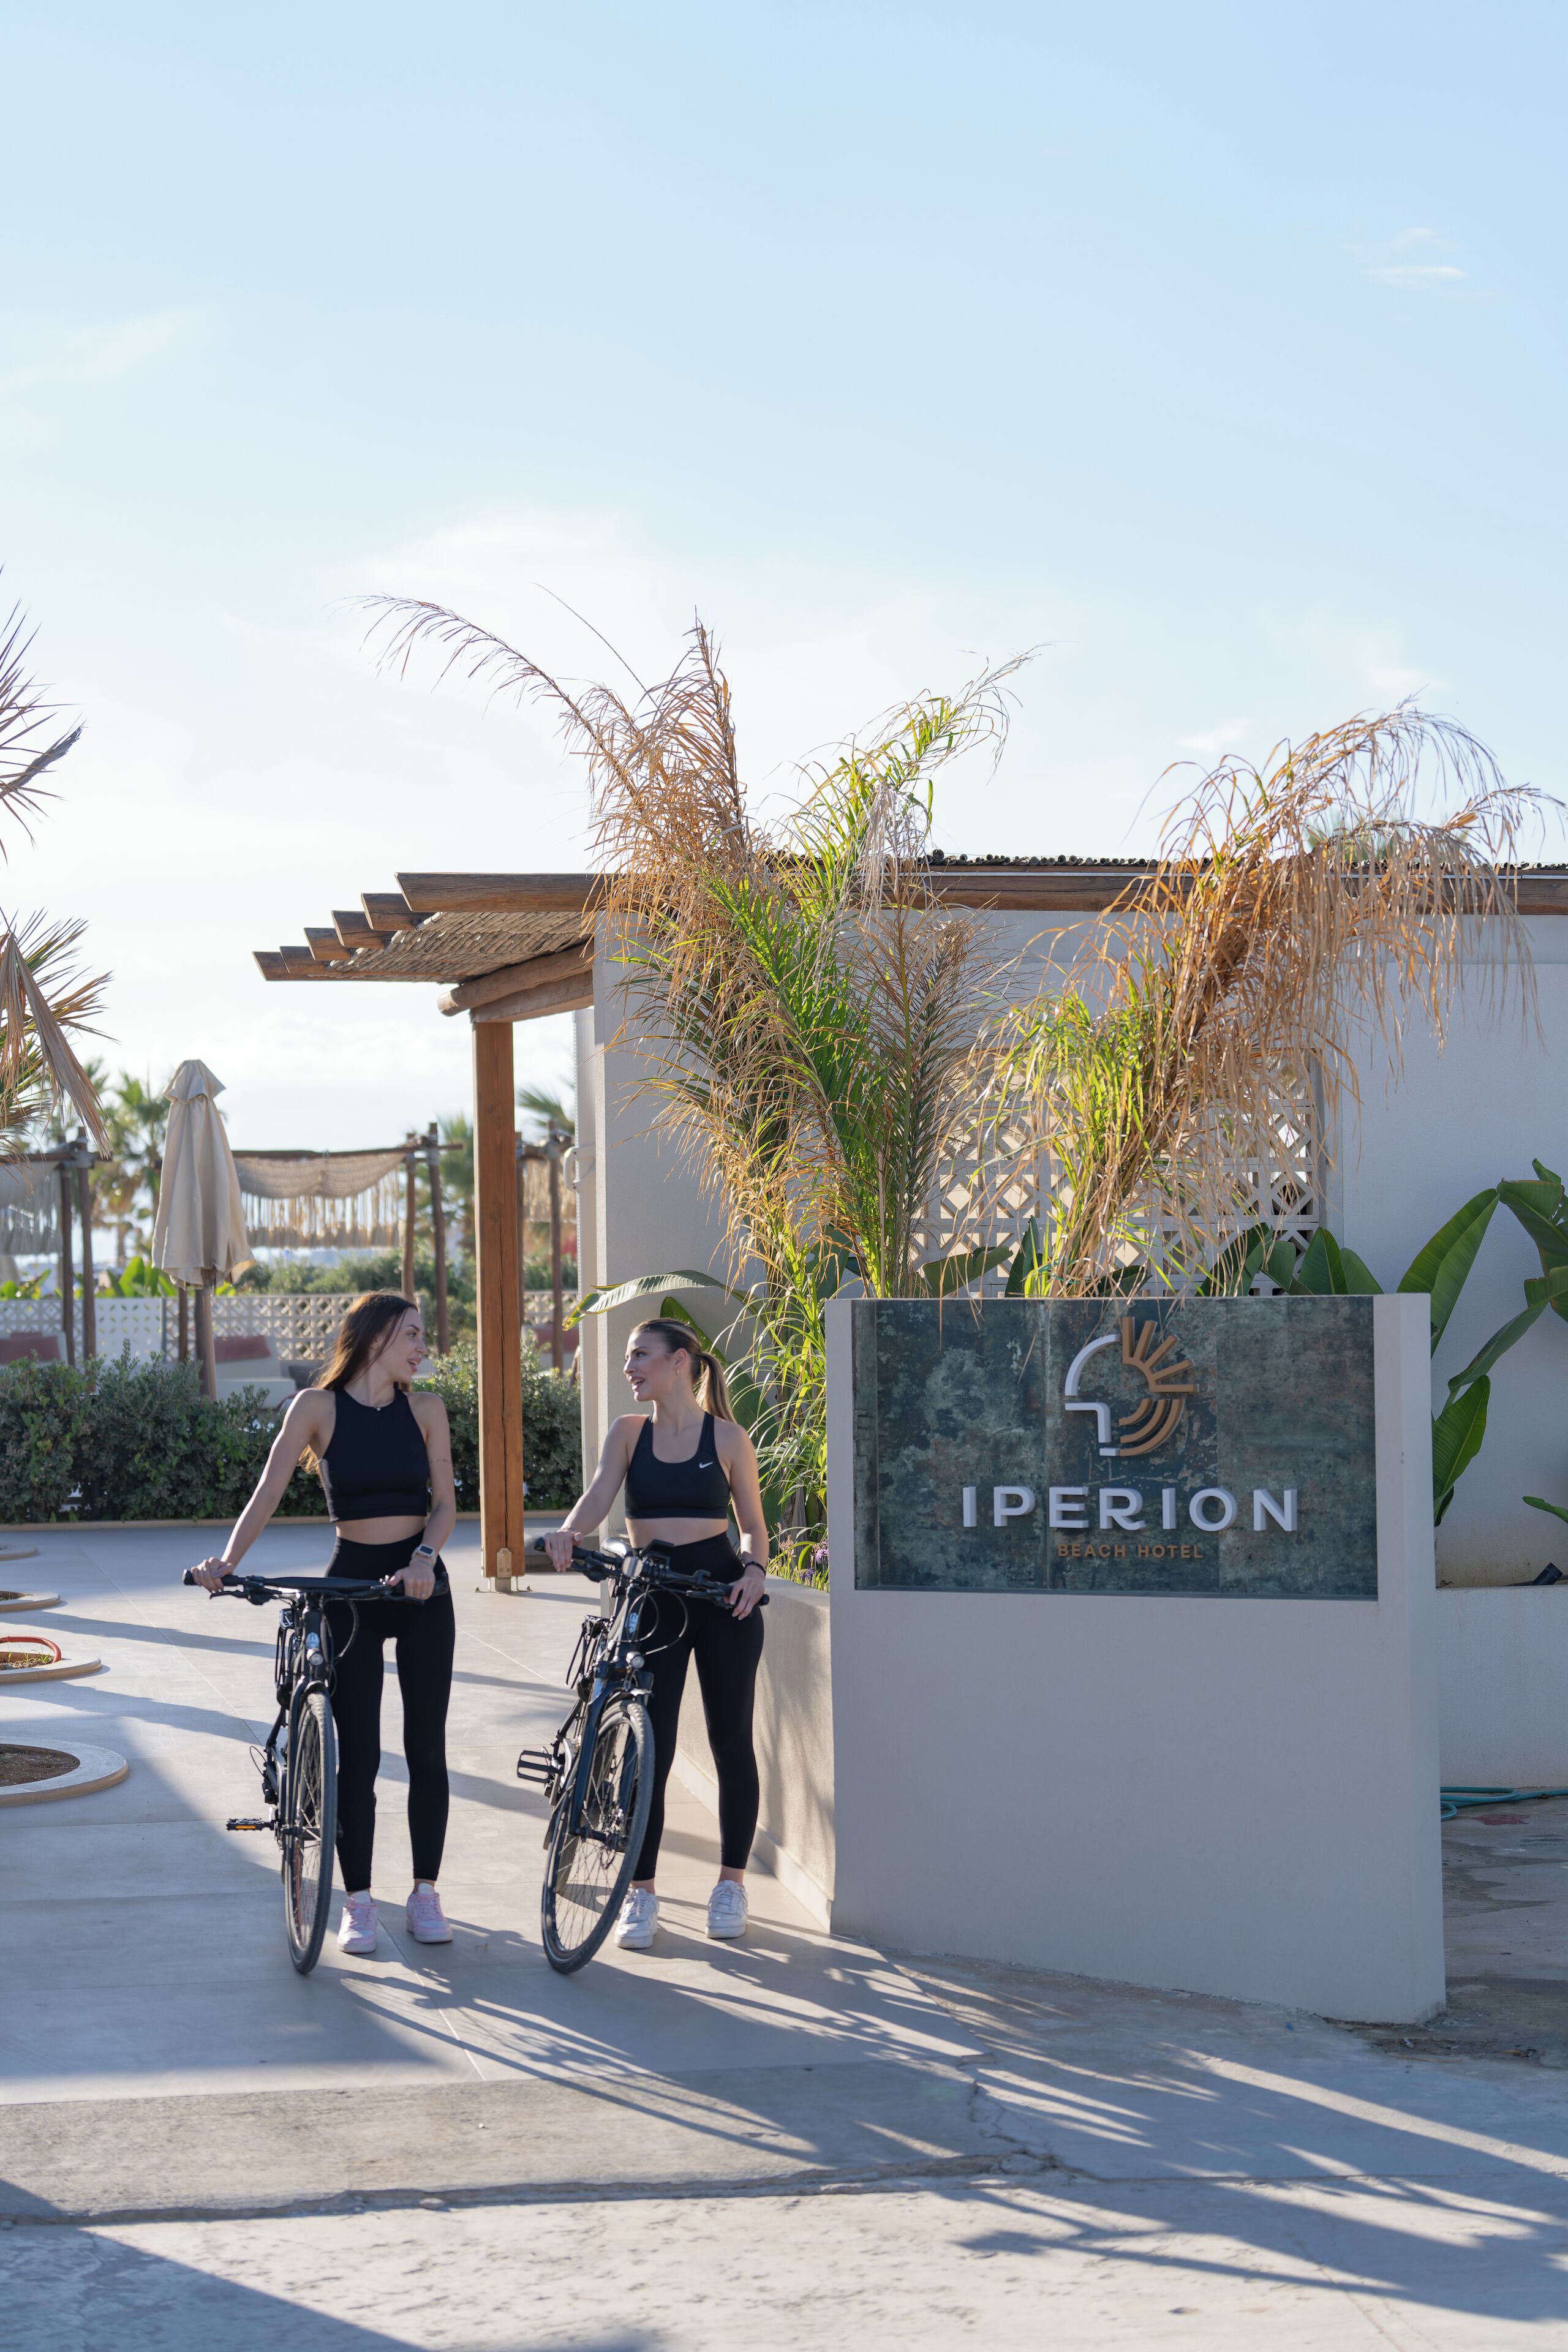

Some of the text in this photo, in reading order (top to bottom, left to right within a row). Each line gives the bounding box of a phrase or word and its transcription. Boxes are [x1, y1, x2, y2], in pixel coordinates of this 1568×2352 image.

[962, 1486, 1298, 1532] IPERION
[1058, 1543, 1204, 1559] BEACH HOTEL
